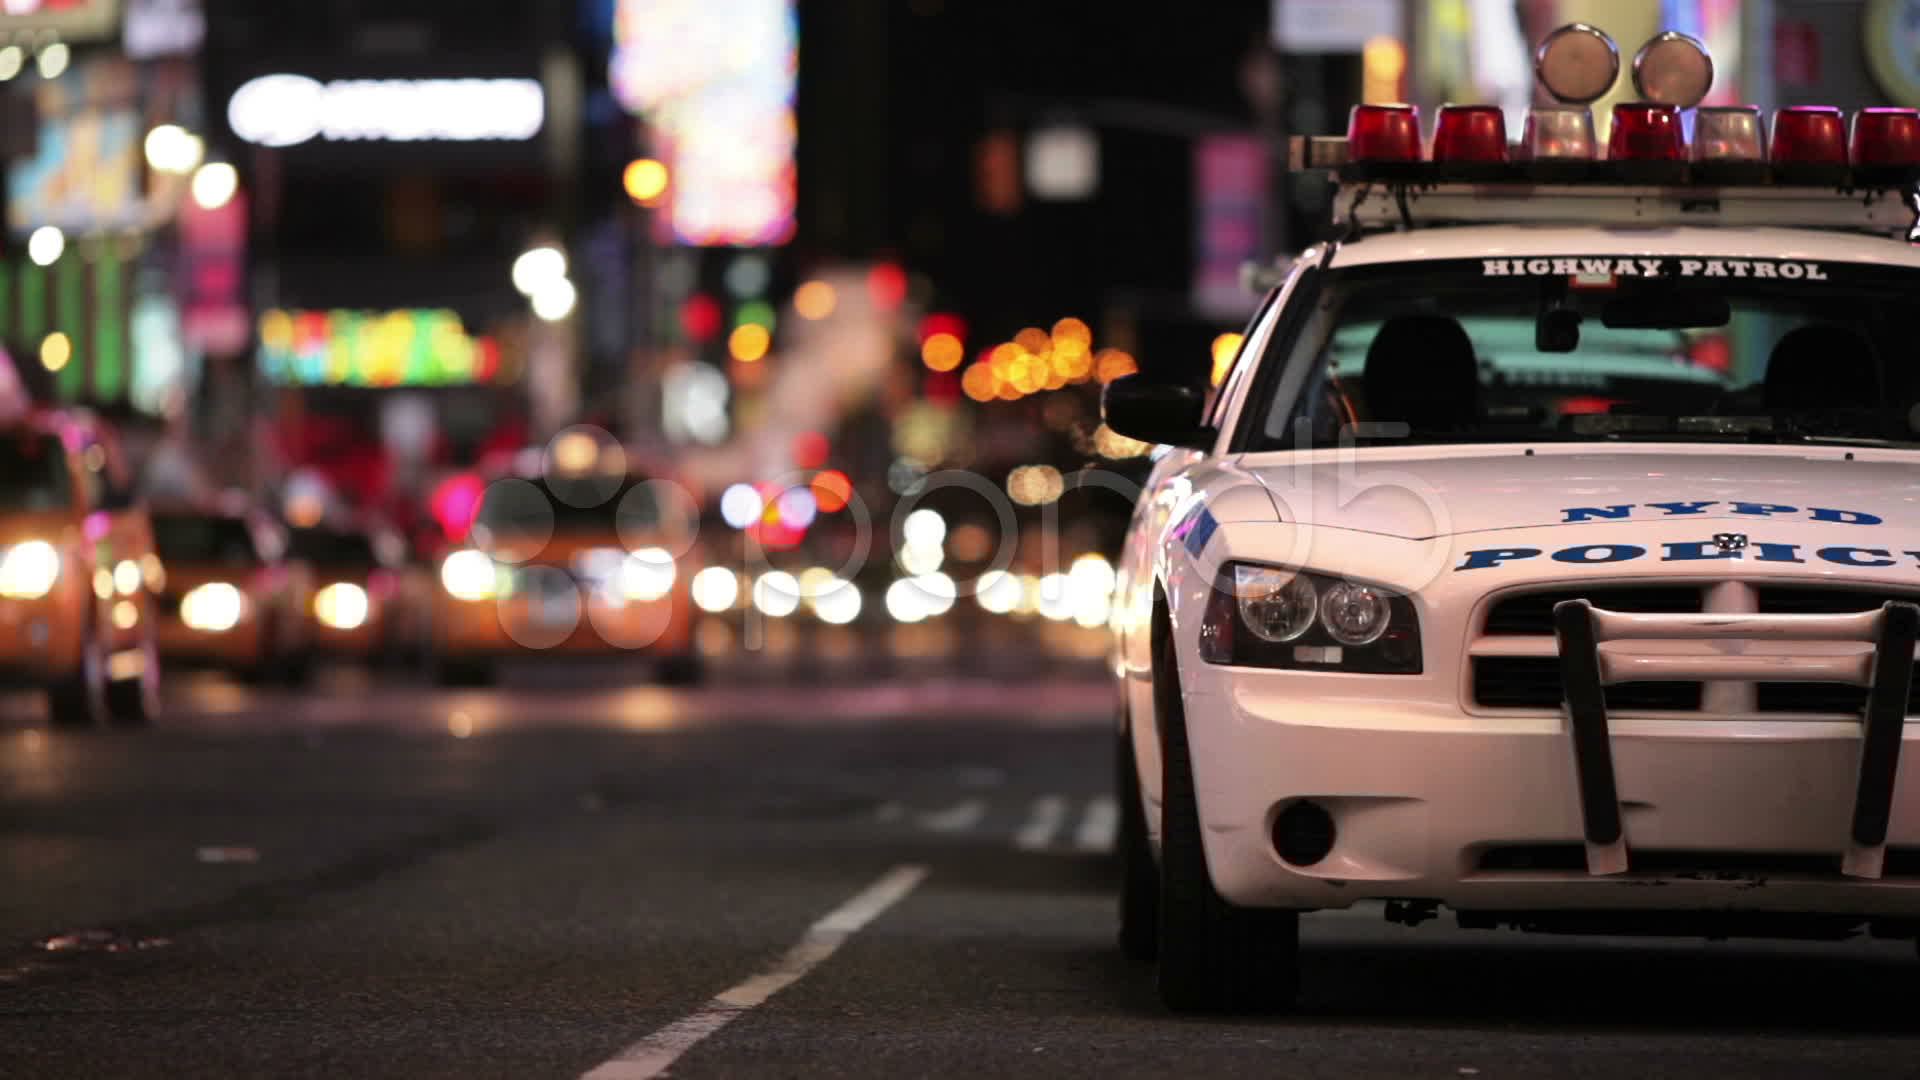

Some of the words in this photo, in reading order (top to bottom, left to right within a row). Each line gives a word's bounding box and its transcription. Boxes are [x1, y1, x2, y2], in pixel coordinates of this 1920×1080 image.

[1482, 259, 1662, 277] HIGHWAY
[1680, 260, 1828, 280] PATROL
[1560, 501, 1883, 525] NYPD
[1453, 541, 1920, 572] POLIC
